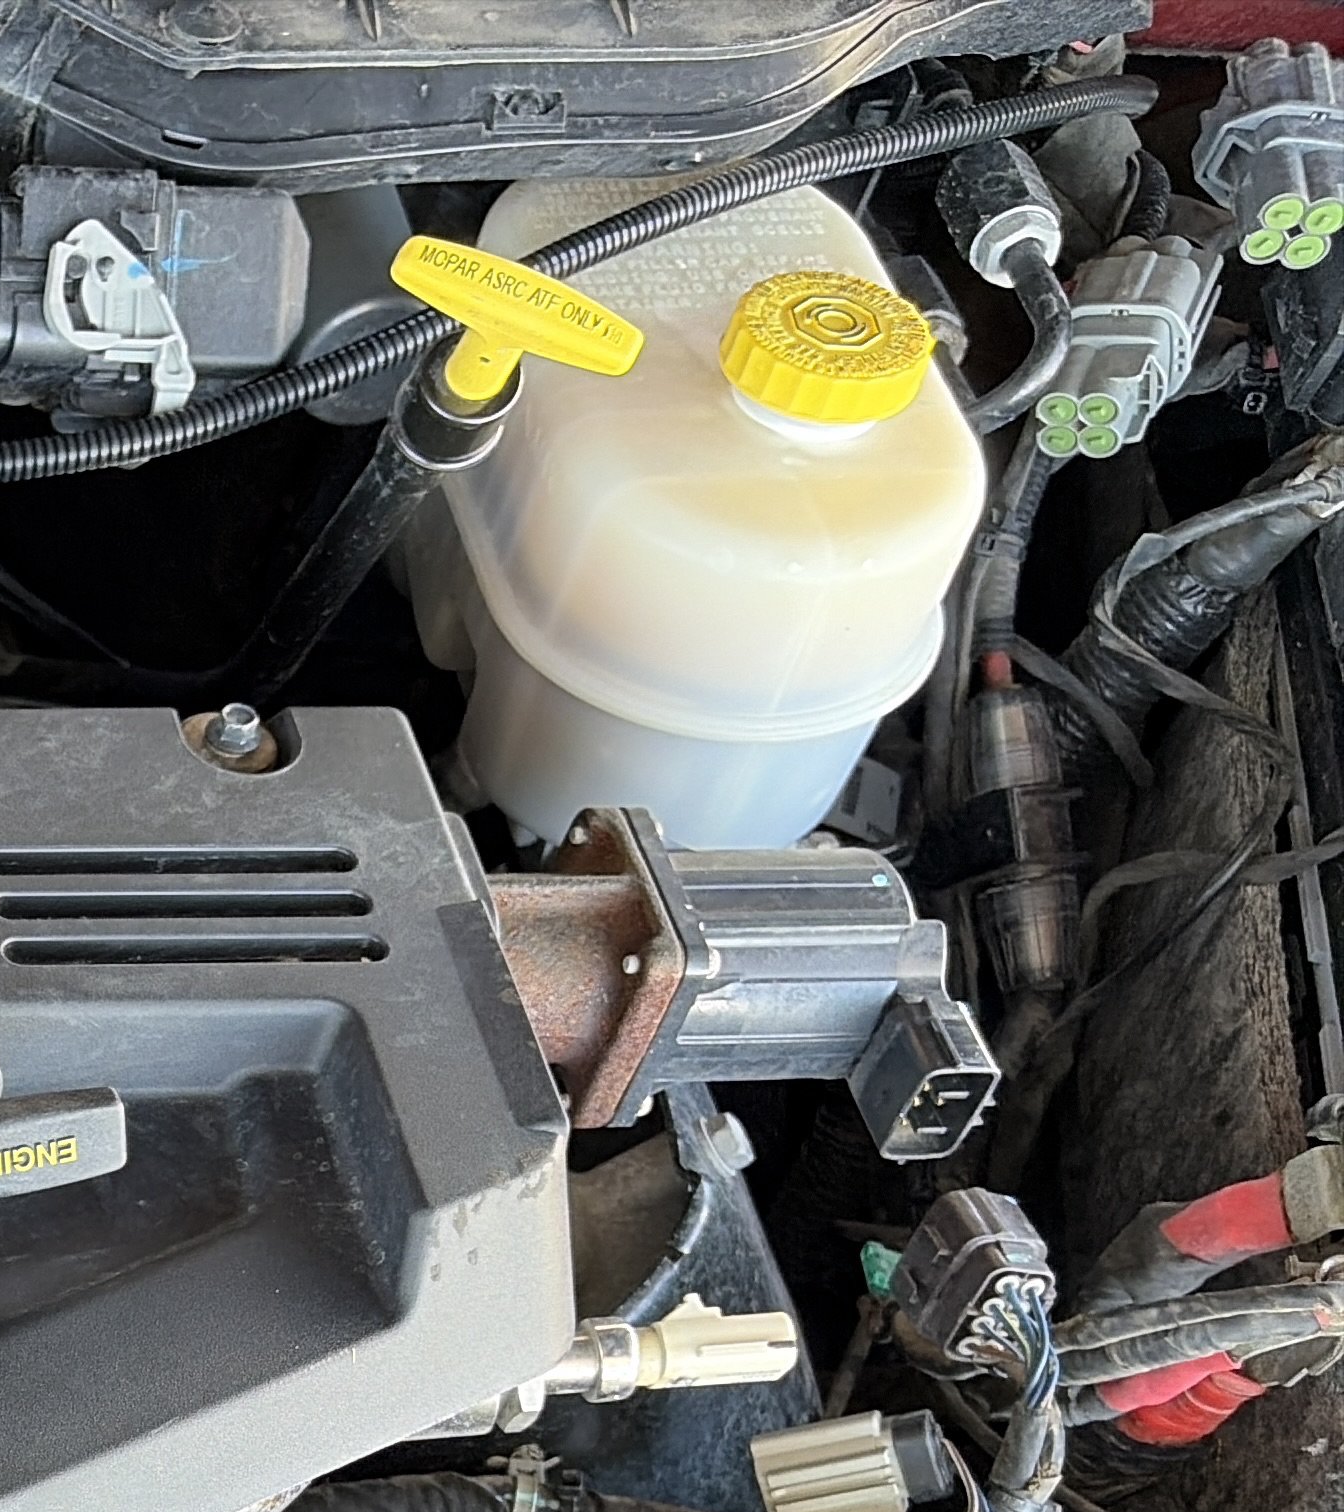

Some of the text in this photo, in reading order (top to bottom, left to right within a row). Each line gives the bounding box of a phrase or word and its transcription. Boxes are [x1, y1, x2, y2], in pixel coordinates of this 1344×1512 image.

[419, 244, 605, 331] MOPAR ASRC ATF ONLY
